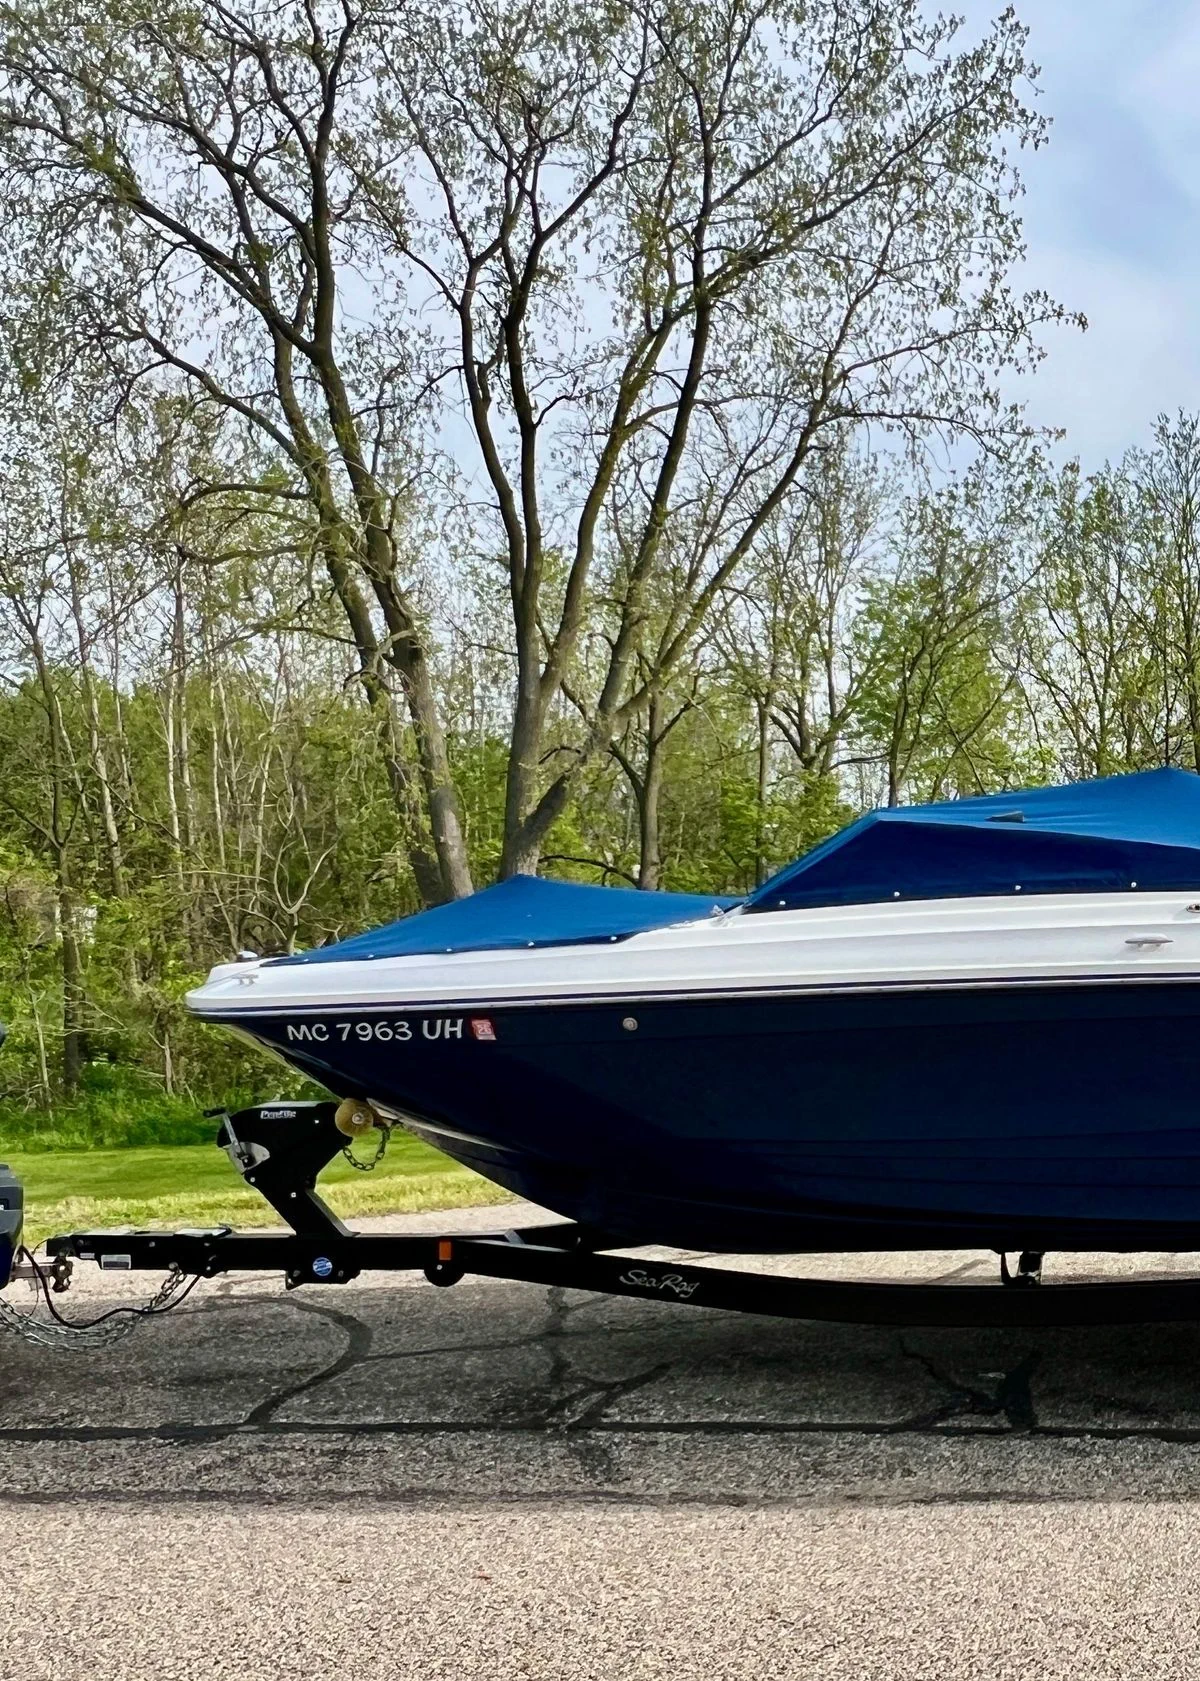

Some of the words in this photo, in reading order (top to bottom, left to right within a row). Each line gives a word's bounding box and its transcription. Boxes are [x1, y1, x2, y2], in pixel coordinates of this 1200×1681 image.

[287, 1024, 330, 1041] MC
[336, 1021, 413, 1041] 7963
[422, 1018, 463, 1040] UH
[619, 1269, 660, 1287] Sea
[660, 1273, 700, 1298] Ray
